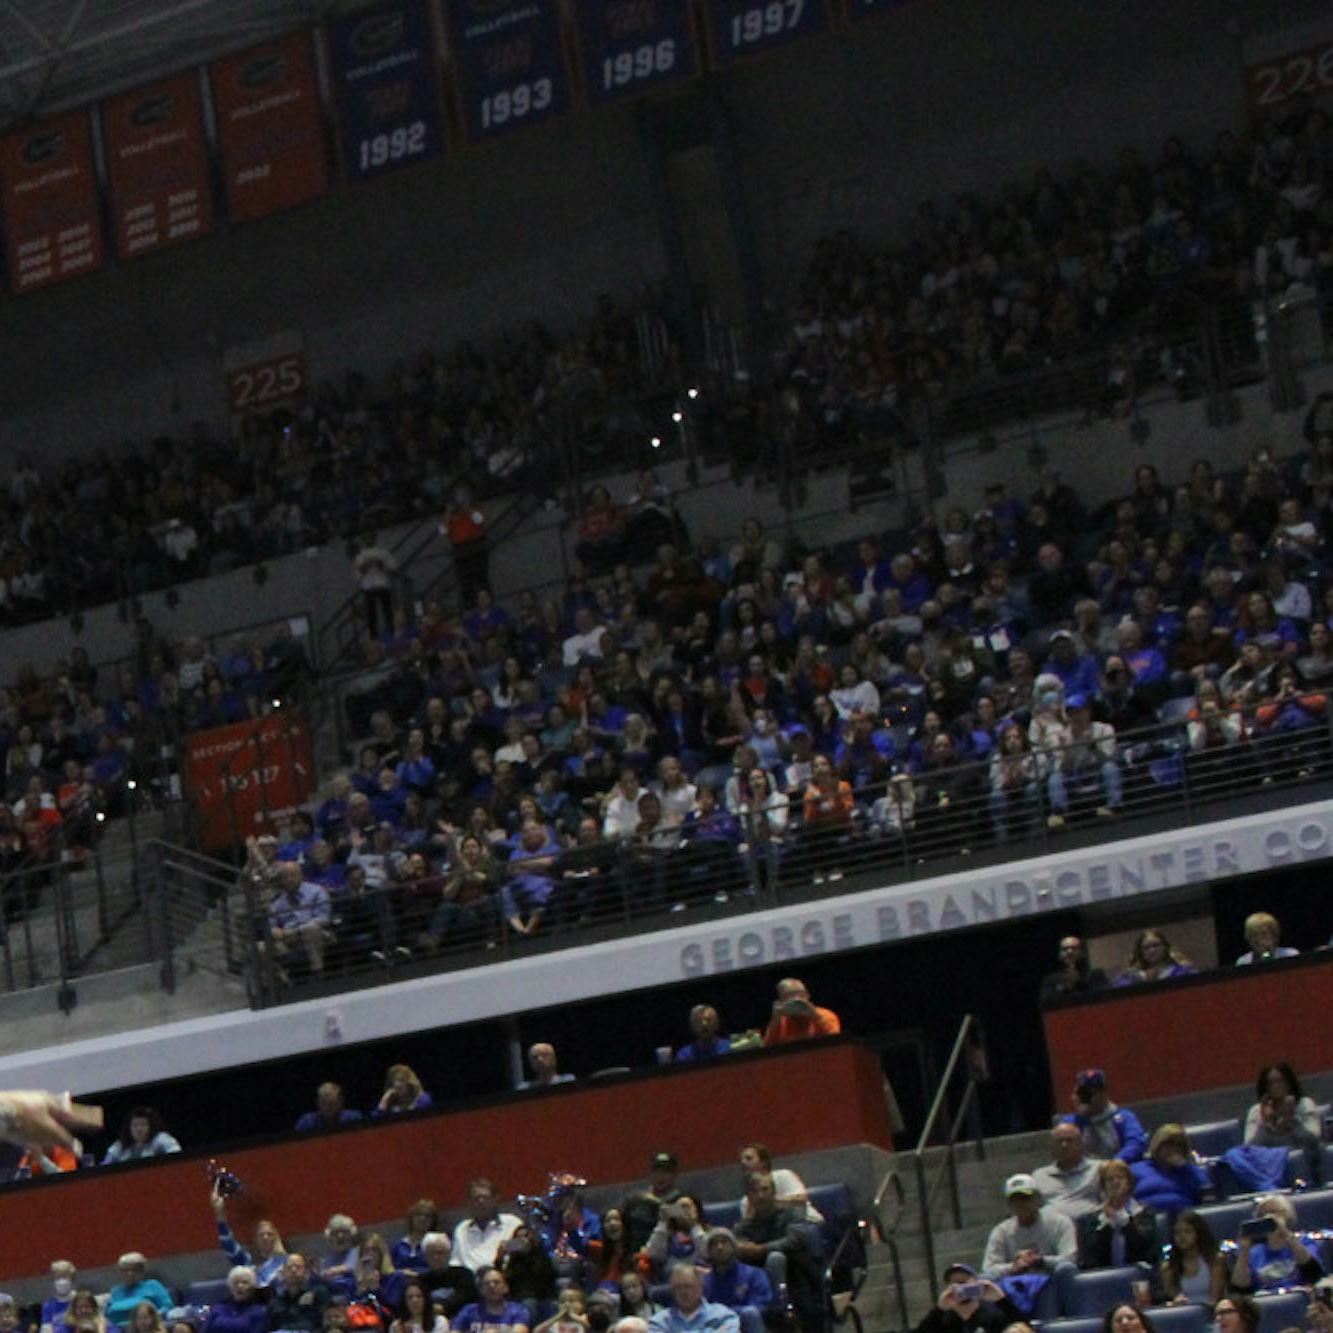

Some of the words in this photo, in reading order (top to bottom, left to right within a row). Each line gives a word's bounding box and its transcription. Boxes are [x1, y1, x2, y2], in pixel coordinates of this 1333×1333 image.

[730, 0, 805, 47] 1997
[603, 38, 676, 90] 1996
[481, 78, 552, 128] 1993
[360, 121, 426, 171] 1992
[233, 359, 302, 407] 225
[679, 913, 853, 976] GEORGE
[1059, 841, 1238, 897] CENTER
